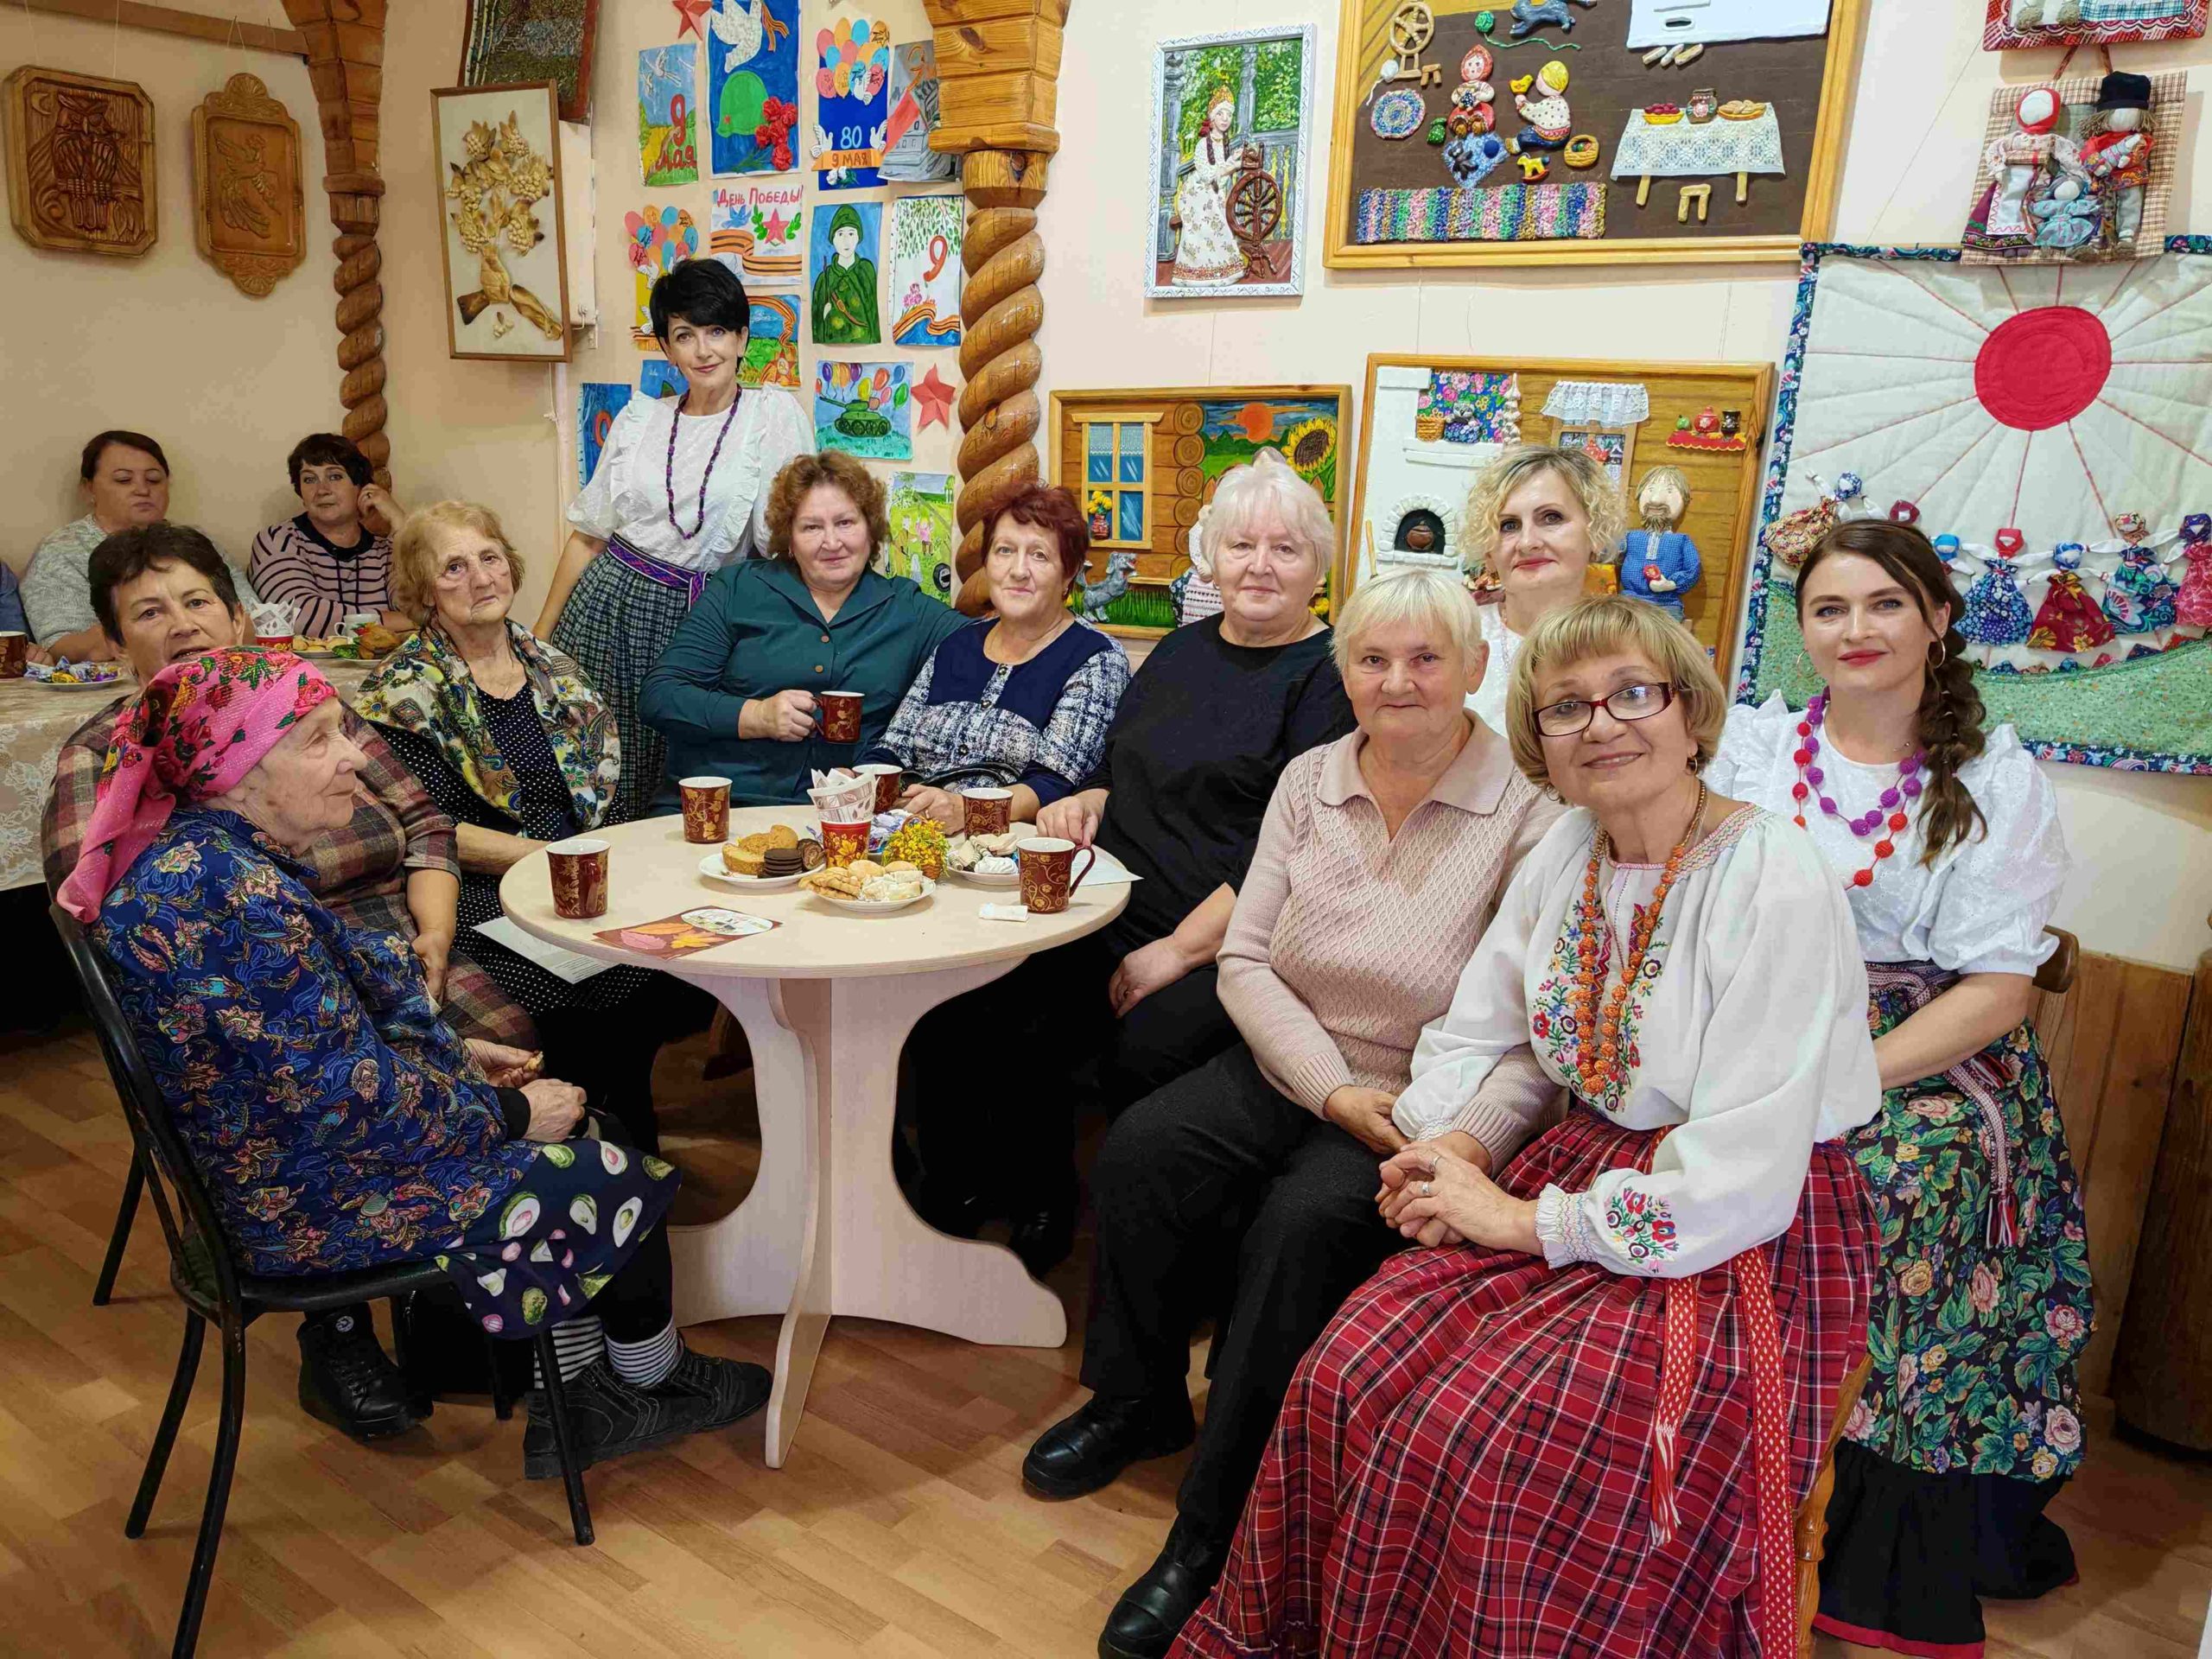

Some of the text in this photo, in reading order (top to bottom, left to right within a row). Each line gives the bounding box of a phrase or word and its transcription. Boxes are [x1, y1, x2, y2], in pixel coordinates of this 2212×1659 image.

[670, 93, 686, 147] 9
[840, 125, 862, 149] 80
[831, 152, 868, 167] 9 МАЯ
[923, 235, 948, 282] 9
